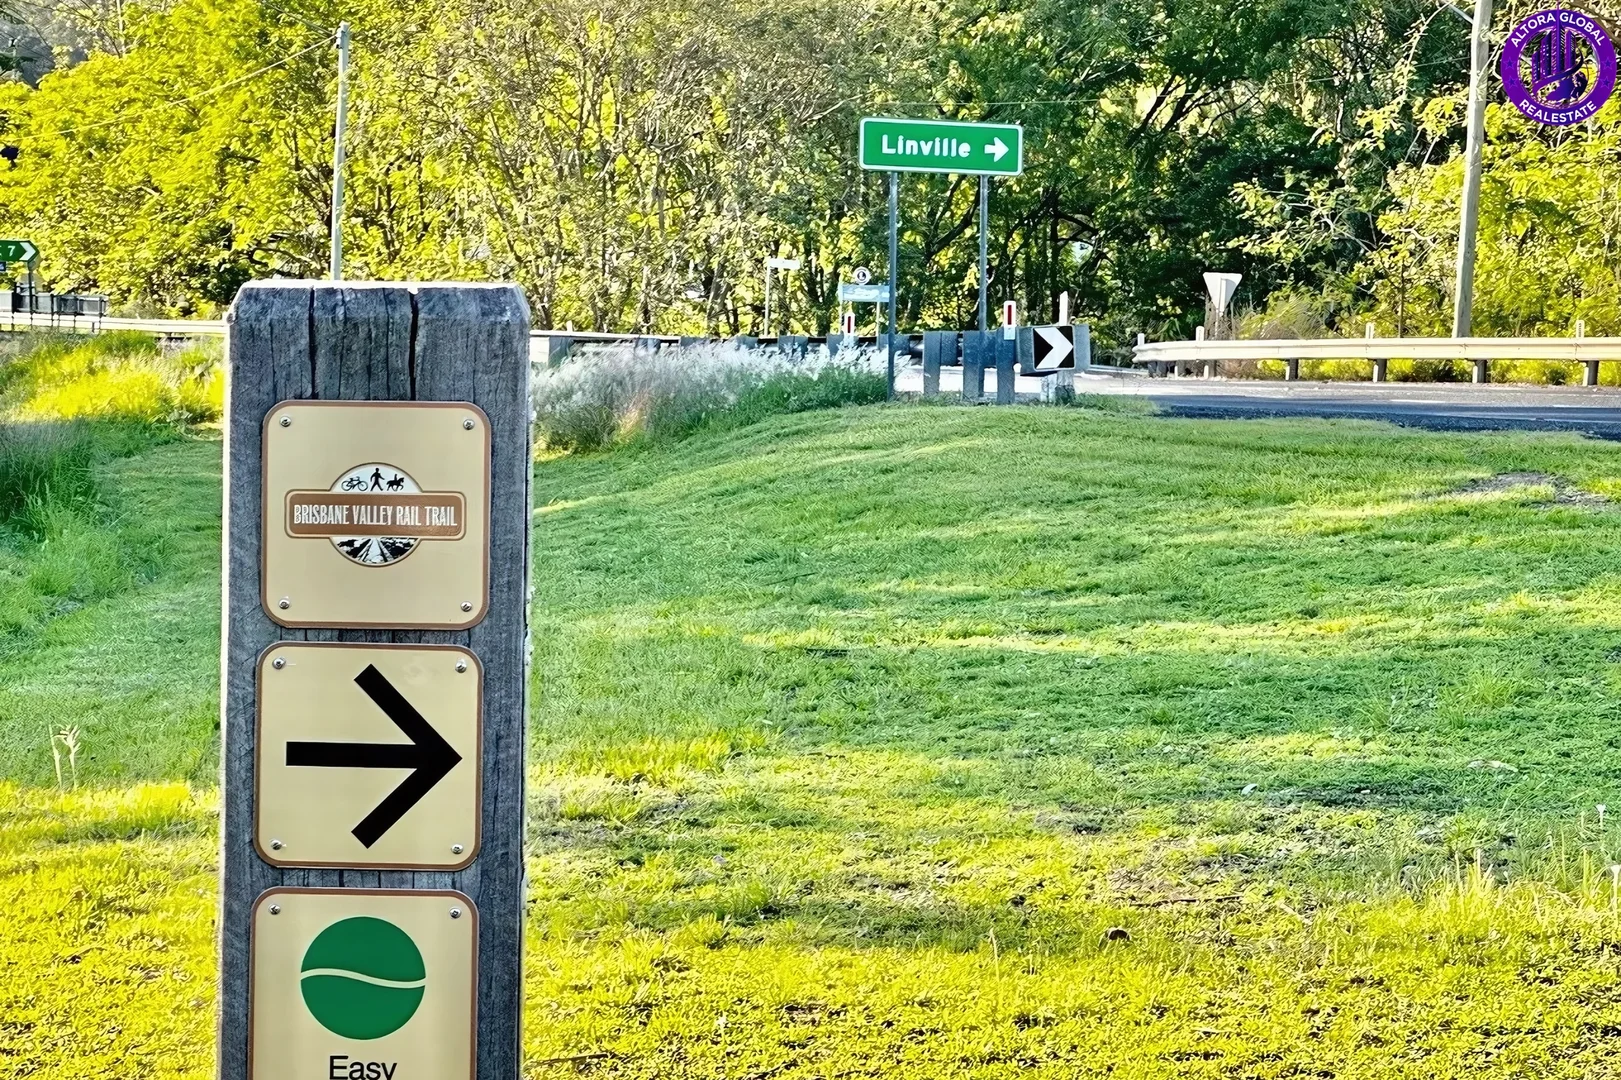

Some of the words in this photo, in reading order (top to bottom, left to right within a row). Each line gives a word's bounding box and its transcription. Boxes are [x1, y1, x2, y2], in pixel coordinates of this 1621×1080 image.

[882, 134, 971, 158] Linville
[7, 245, 16, 257] 7
[293, 504, 350, 525] BRISBANE
[352, 505, 393, 526] VALLEY
[396, 505, 422, 526] RAIL
[425, 506, 458, 527] TRAIL
[329, 1055, 398, 1080] Easy
